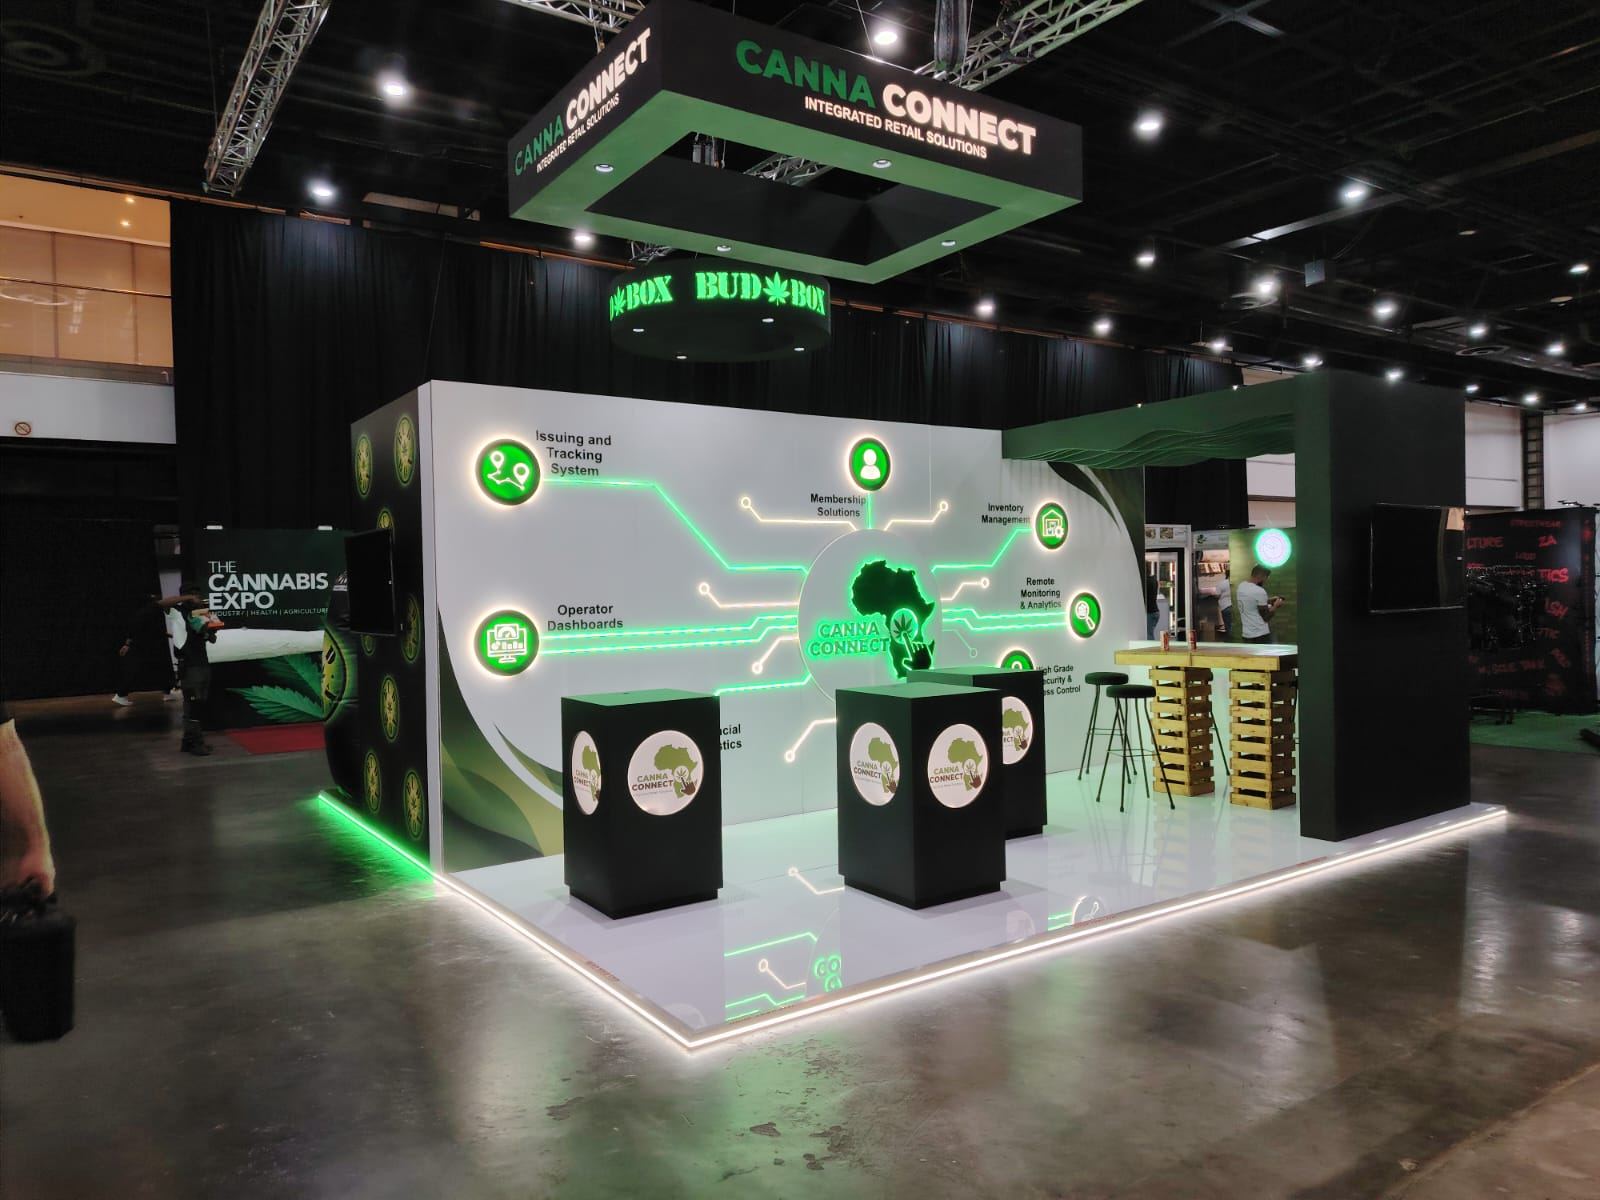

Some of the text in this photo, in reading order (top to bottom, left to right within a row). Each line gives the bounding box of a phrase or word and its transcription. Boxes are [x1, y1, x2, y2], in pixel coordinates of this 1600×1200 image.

[514, 27, 651, 176] CANNA CONNECT
[735, 39, 1037, 155] CANNA CONNECT
[536, 92, 620, 174] INTEGRATED RETAIL SOLUTIONS
[804, 95, 988, 160] INTEGRATED RETAIL SOLUTIONS
[626, 274, 673, 311] BOX
[695, 271, 826, 316] BUD BOX
[536, 429, 612, 447] Issuing and
[546, 446, 603, 464] Tracking
[551, 463, 599, 477] System
[810, 493, 867, 506] Membership
[817, 506, 861, 517] Solutions
[988, 503, 1024, 514] Inventory
[981, 514, 1031, 526] Management
[208, 560, 237, 574] THE
[208, 572, 329, 592] CANNABIS
[1026, 577, 1055, 586] Remote
[1020, 588, 1061, 598] Monitoring
[208, 591, 275, 610] EXPO
[1020, 600, 1062, 610] & Analytics
[557, 604, 614, 618] Operator
[547, 618, 624, 631] Dashboards
[819, 621, 880, 638] CANNA
[809, 637, 890, 656] CONNECT
[1053, 664, 1074, 673] Grade
[1044, 674, 1073, 685] ecurity &
[1056, 685, 1081, 695] Control
[720, 723, 741, 735] cial
[637, 772, 669, 782] CANNA
[853, 767, 881, 779] CONNECT
[934, 766, 960, 775] CANNA
[929, 773, 963, 783] CONNECT
[631, 780, 674, 791] CONNECT
